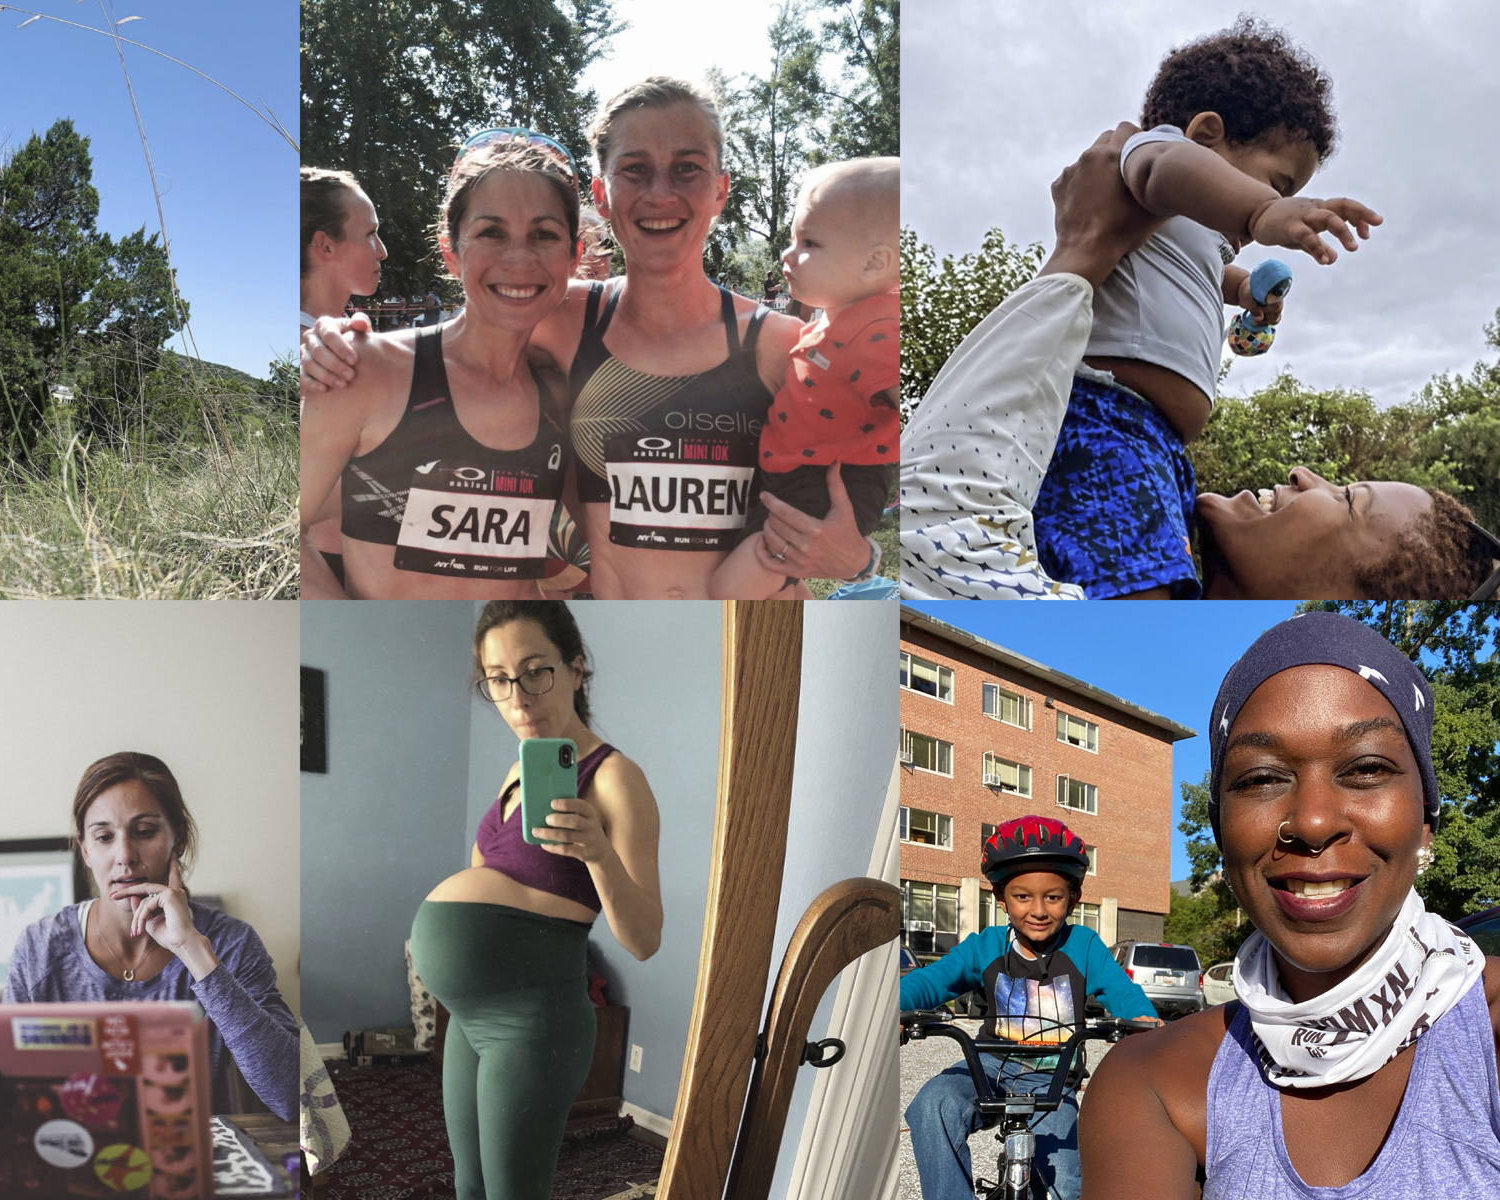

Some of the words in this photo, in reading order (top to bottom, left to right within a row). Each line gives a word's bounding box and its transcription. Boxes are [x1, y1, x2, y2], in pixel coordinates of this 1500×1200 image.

[664, 408, 762, 438] oiselle
[683, 444, 708, 460] MINI
[495, 476, 517, 492] MINI
[612, 474, 749, 516] LAUREN
[427, 504, 531, 546] SARA
[473, 564, 489, 572] RUN
[1295, 959, 1414, 1046] MXN
[1291, 1027, 1326, 1046] RUN
[1305, 1045, 1328, 1059] THE
